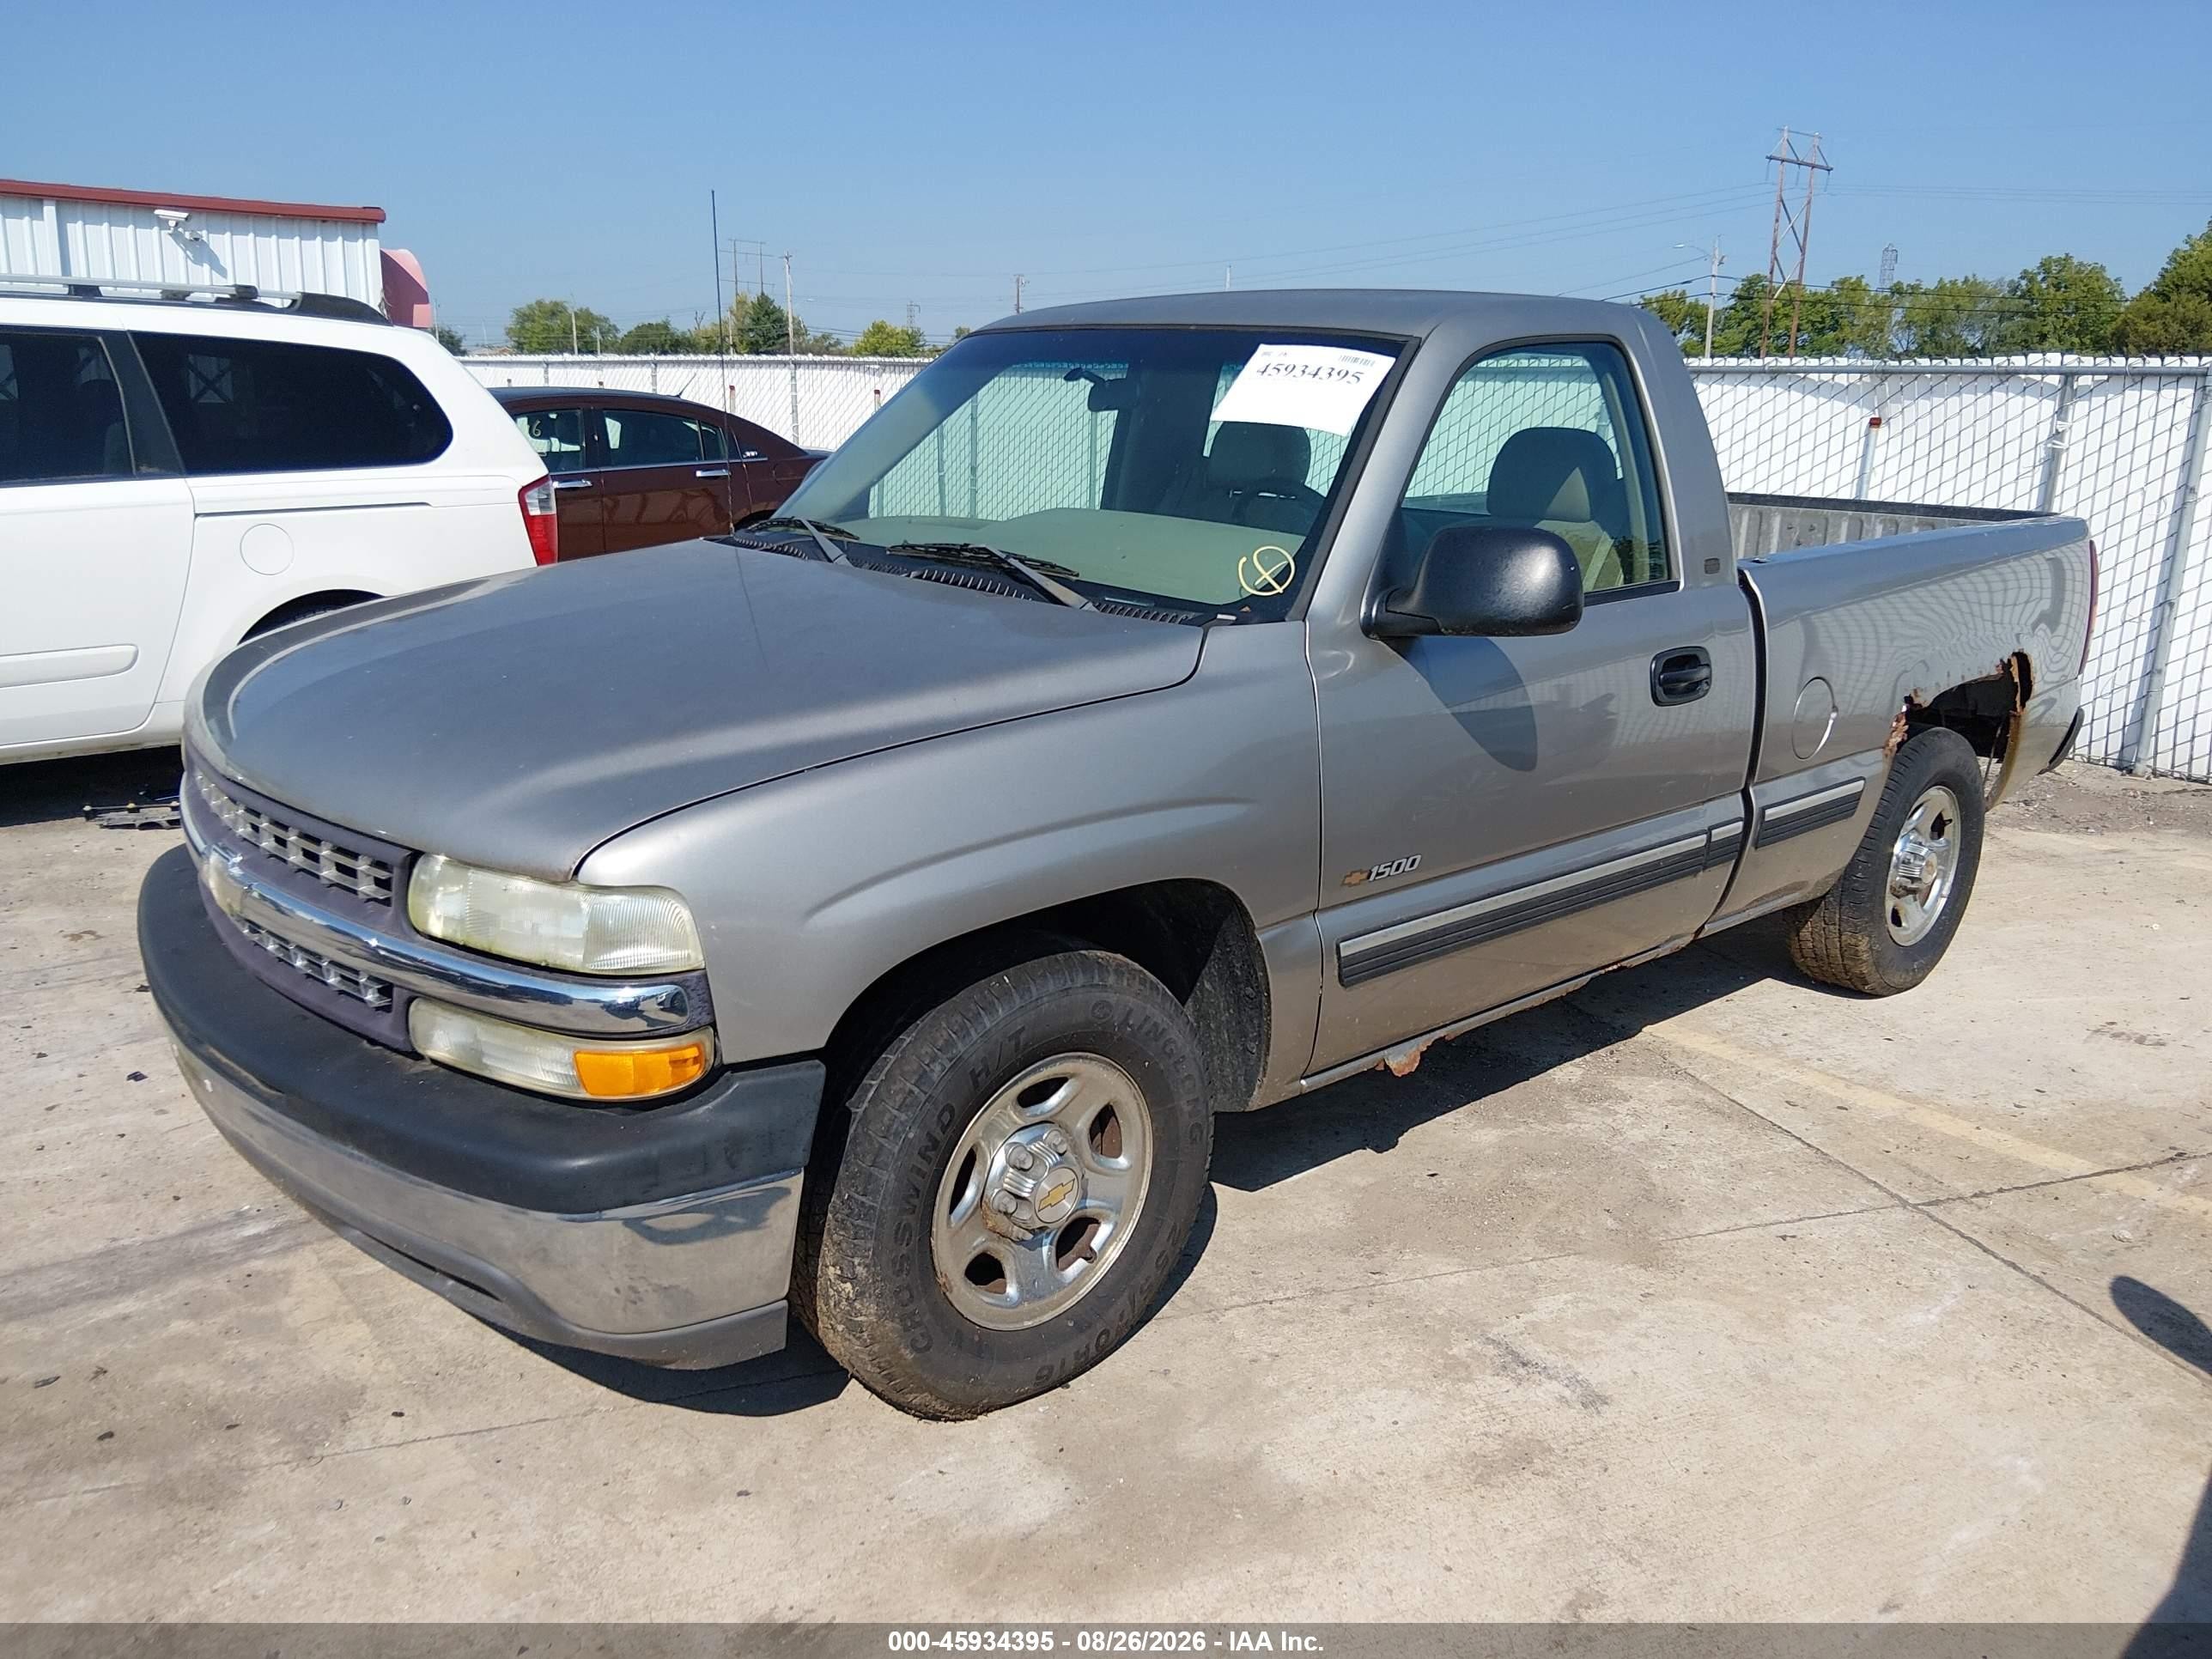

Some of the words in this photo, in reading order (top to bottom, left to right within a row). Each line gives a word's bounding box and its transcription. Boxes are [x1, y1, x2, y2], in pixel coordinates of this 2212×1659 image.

[1256, 362, 1364, 385] 45934395
[1368, 854, 1422, 882] 1500
[891, 1101, 957, 1355] CROSSWIND
[968, 1024, 1026, 1091] H/T
